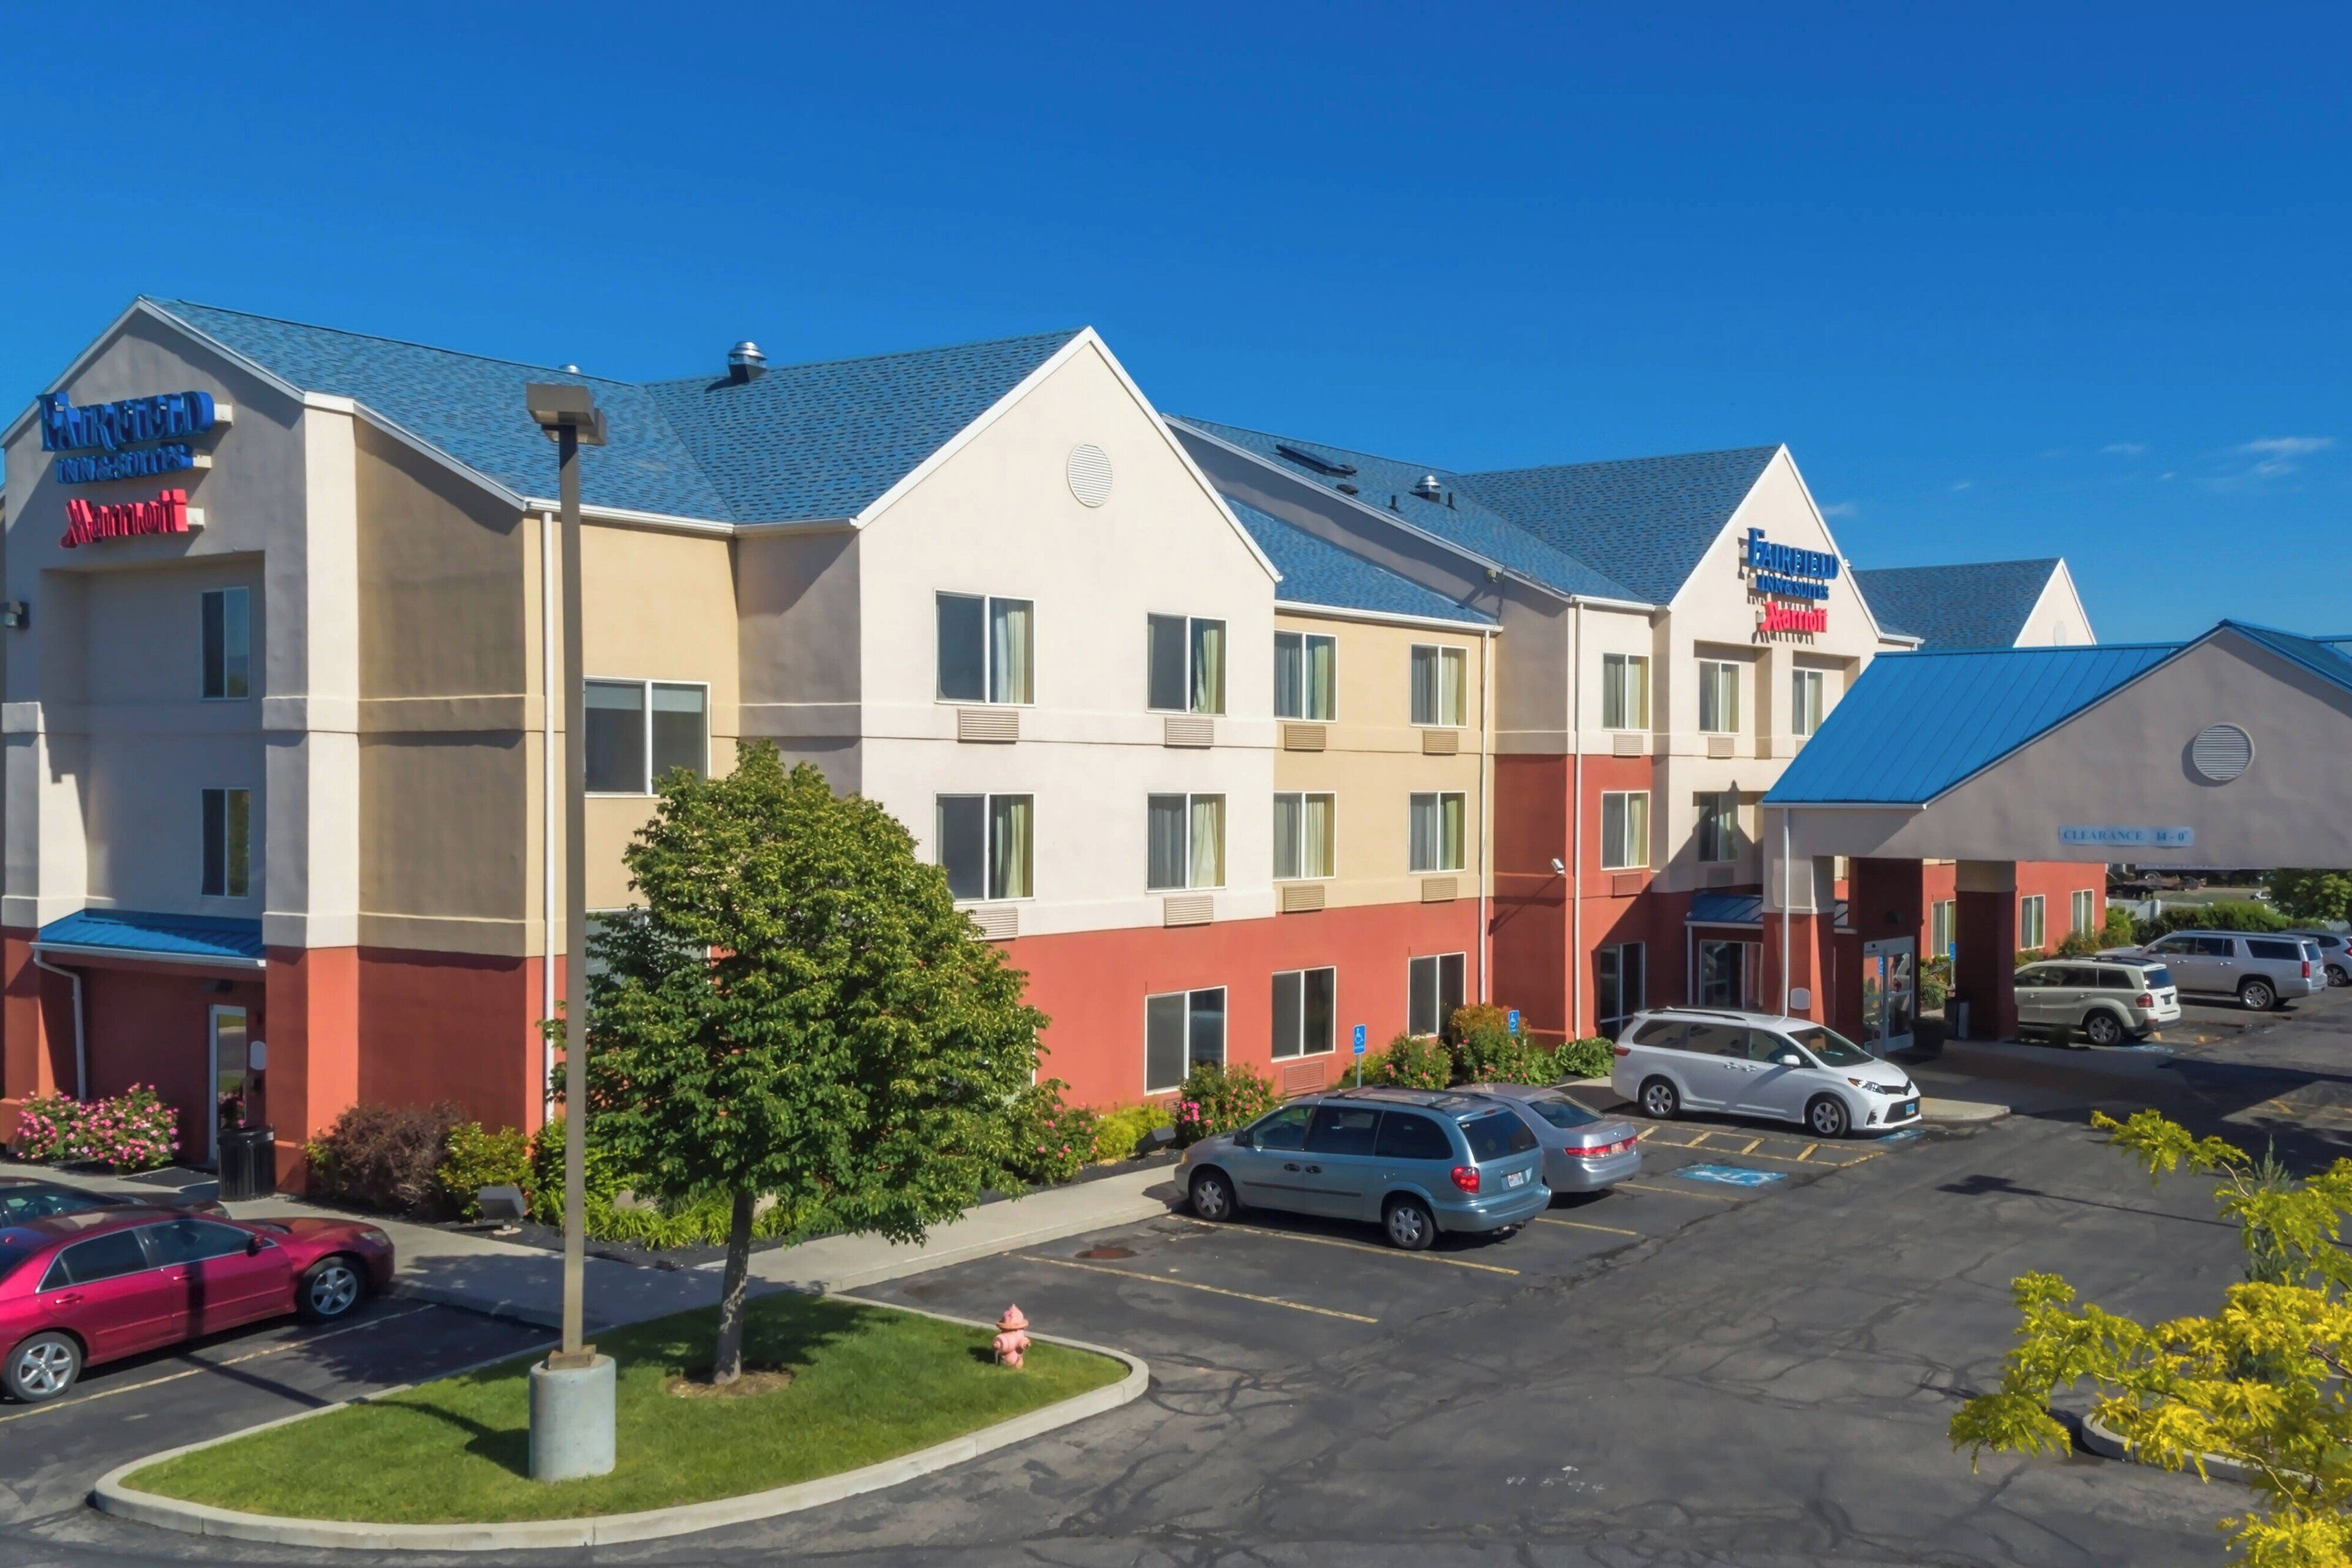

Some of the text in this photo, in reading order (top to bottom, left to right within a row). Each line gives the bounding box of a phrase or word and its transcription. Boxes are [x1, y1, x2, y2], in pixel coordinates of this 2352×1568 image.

[56, 457, 96, 483] INN
[59, 489, 189, 548] Marriott
[1747, 527, 1839, 579] FAIRFIELD
[1757, 575, 1829, 600] INN & SUITES
[1760, 601, 1827, 633] Marriott
[2063, 830, 2143, 841] CLEARANCE
